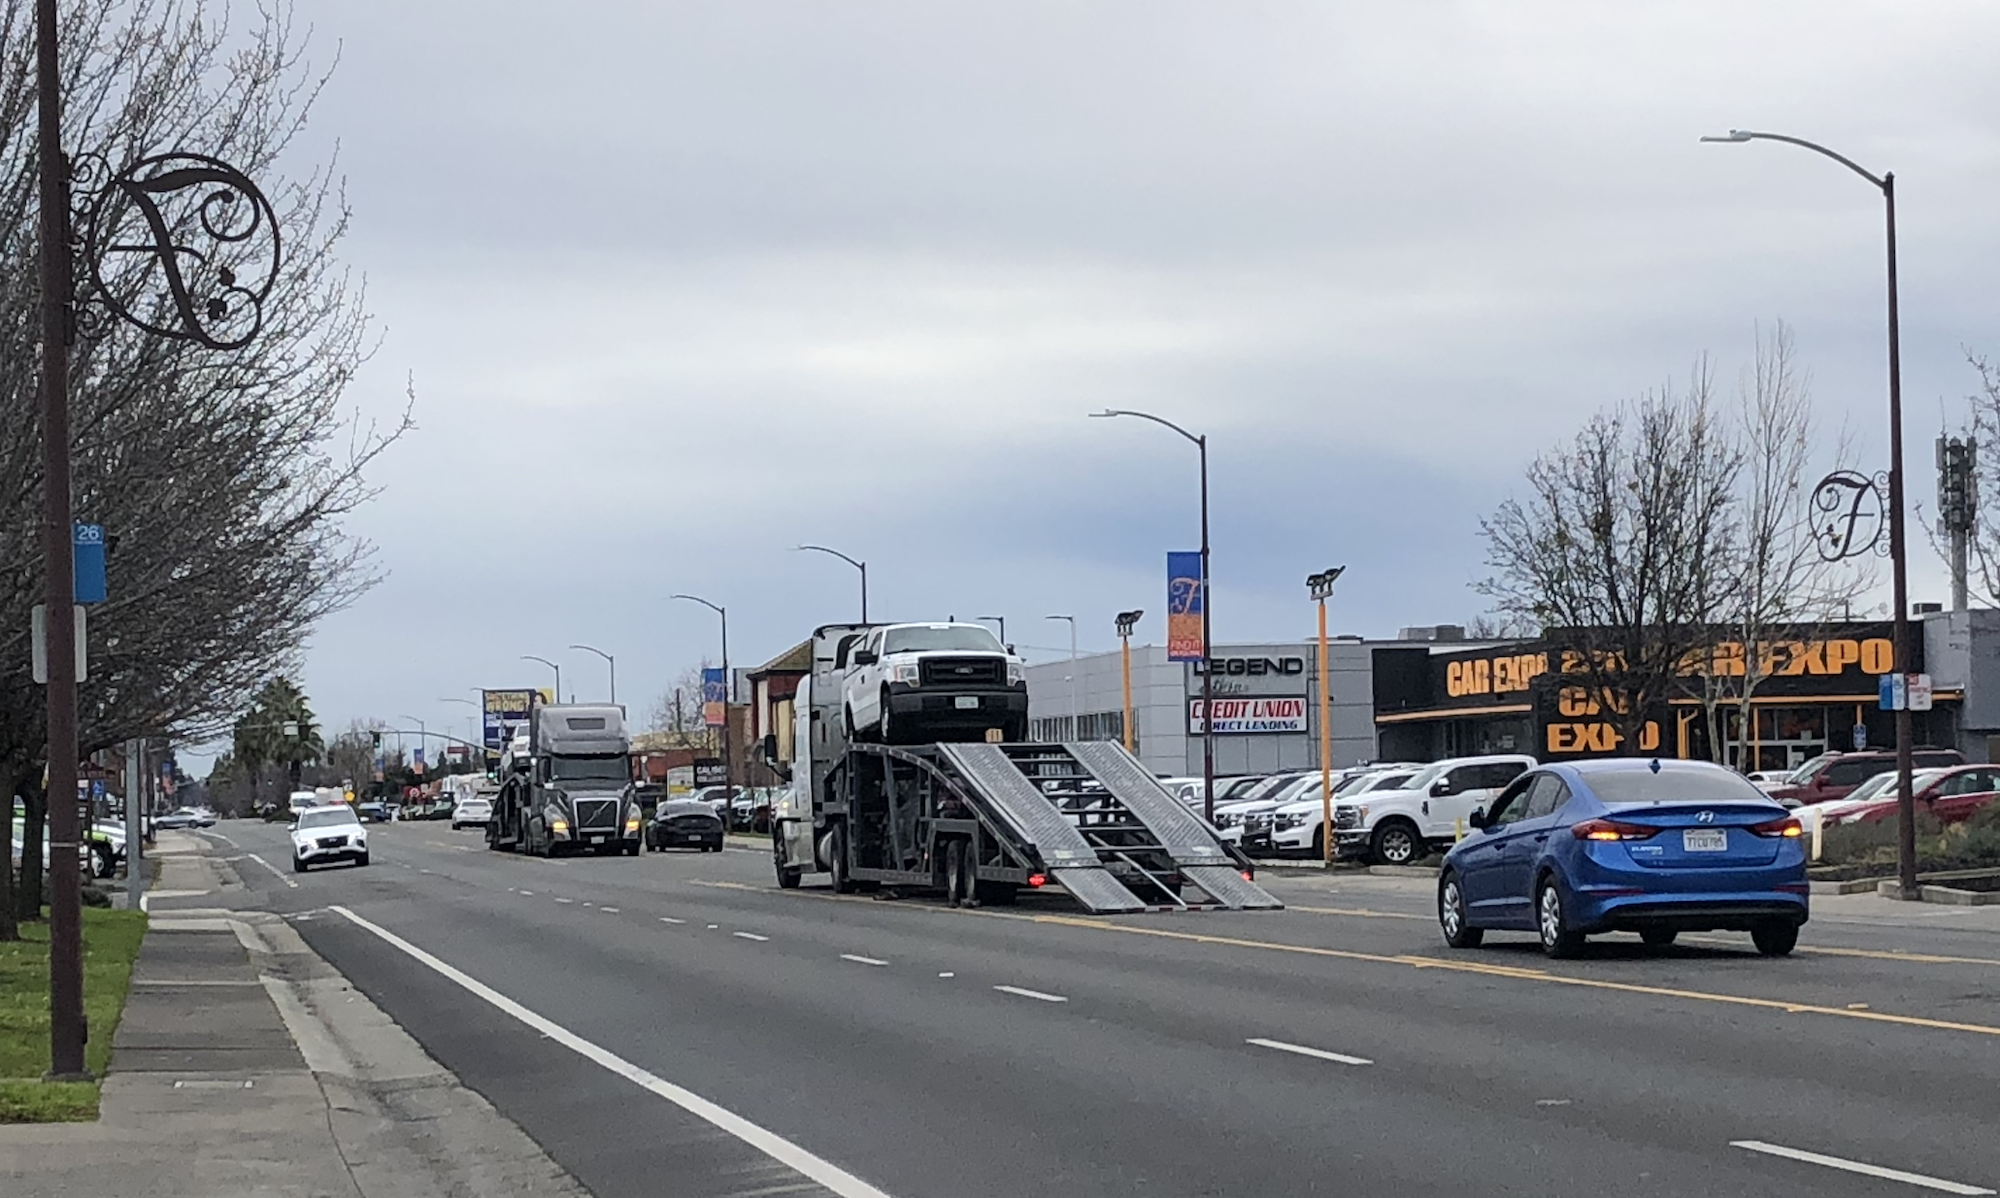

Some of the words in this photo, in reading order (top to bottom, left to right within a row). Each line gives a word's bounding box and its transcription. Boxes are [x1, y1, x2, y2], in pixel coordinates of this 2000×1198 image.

[78, 525, 99, 540] 26
[1170, 640, 1192, 650] FIND
[1194, 657, 1303, 676] LEGEND
[1447, 659, 1490, 698] CAR
[1252, 700, 1304, 718] UNION
[1245, 720, 1298, 731] LENDING
